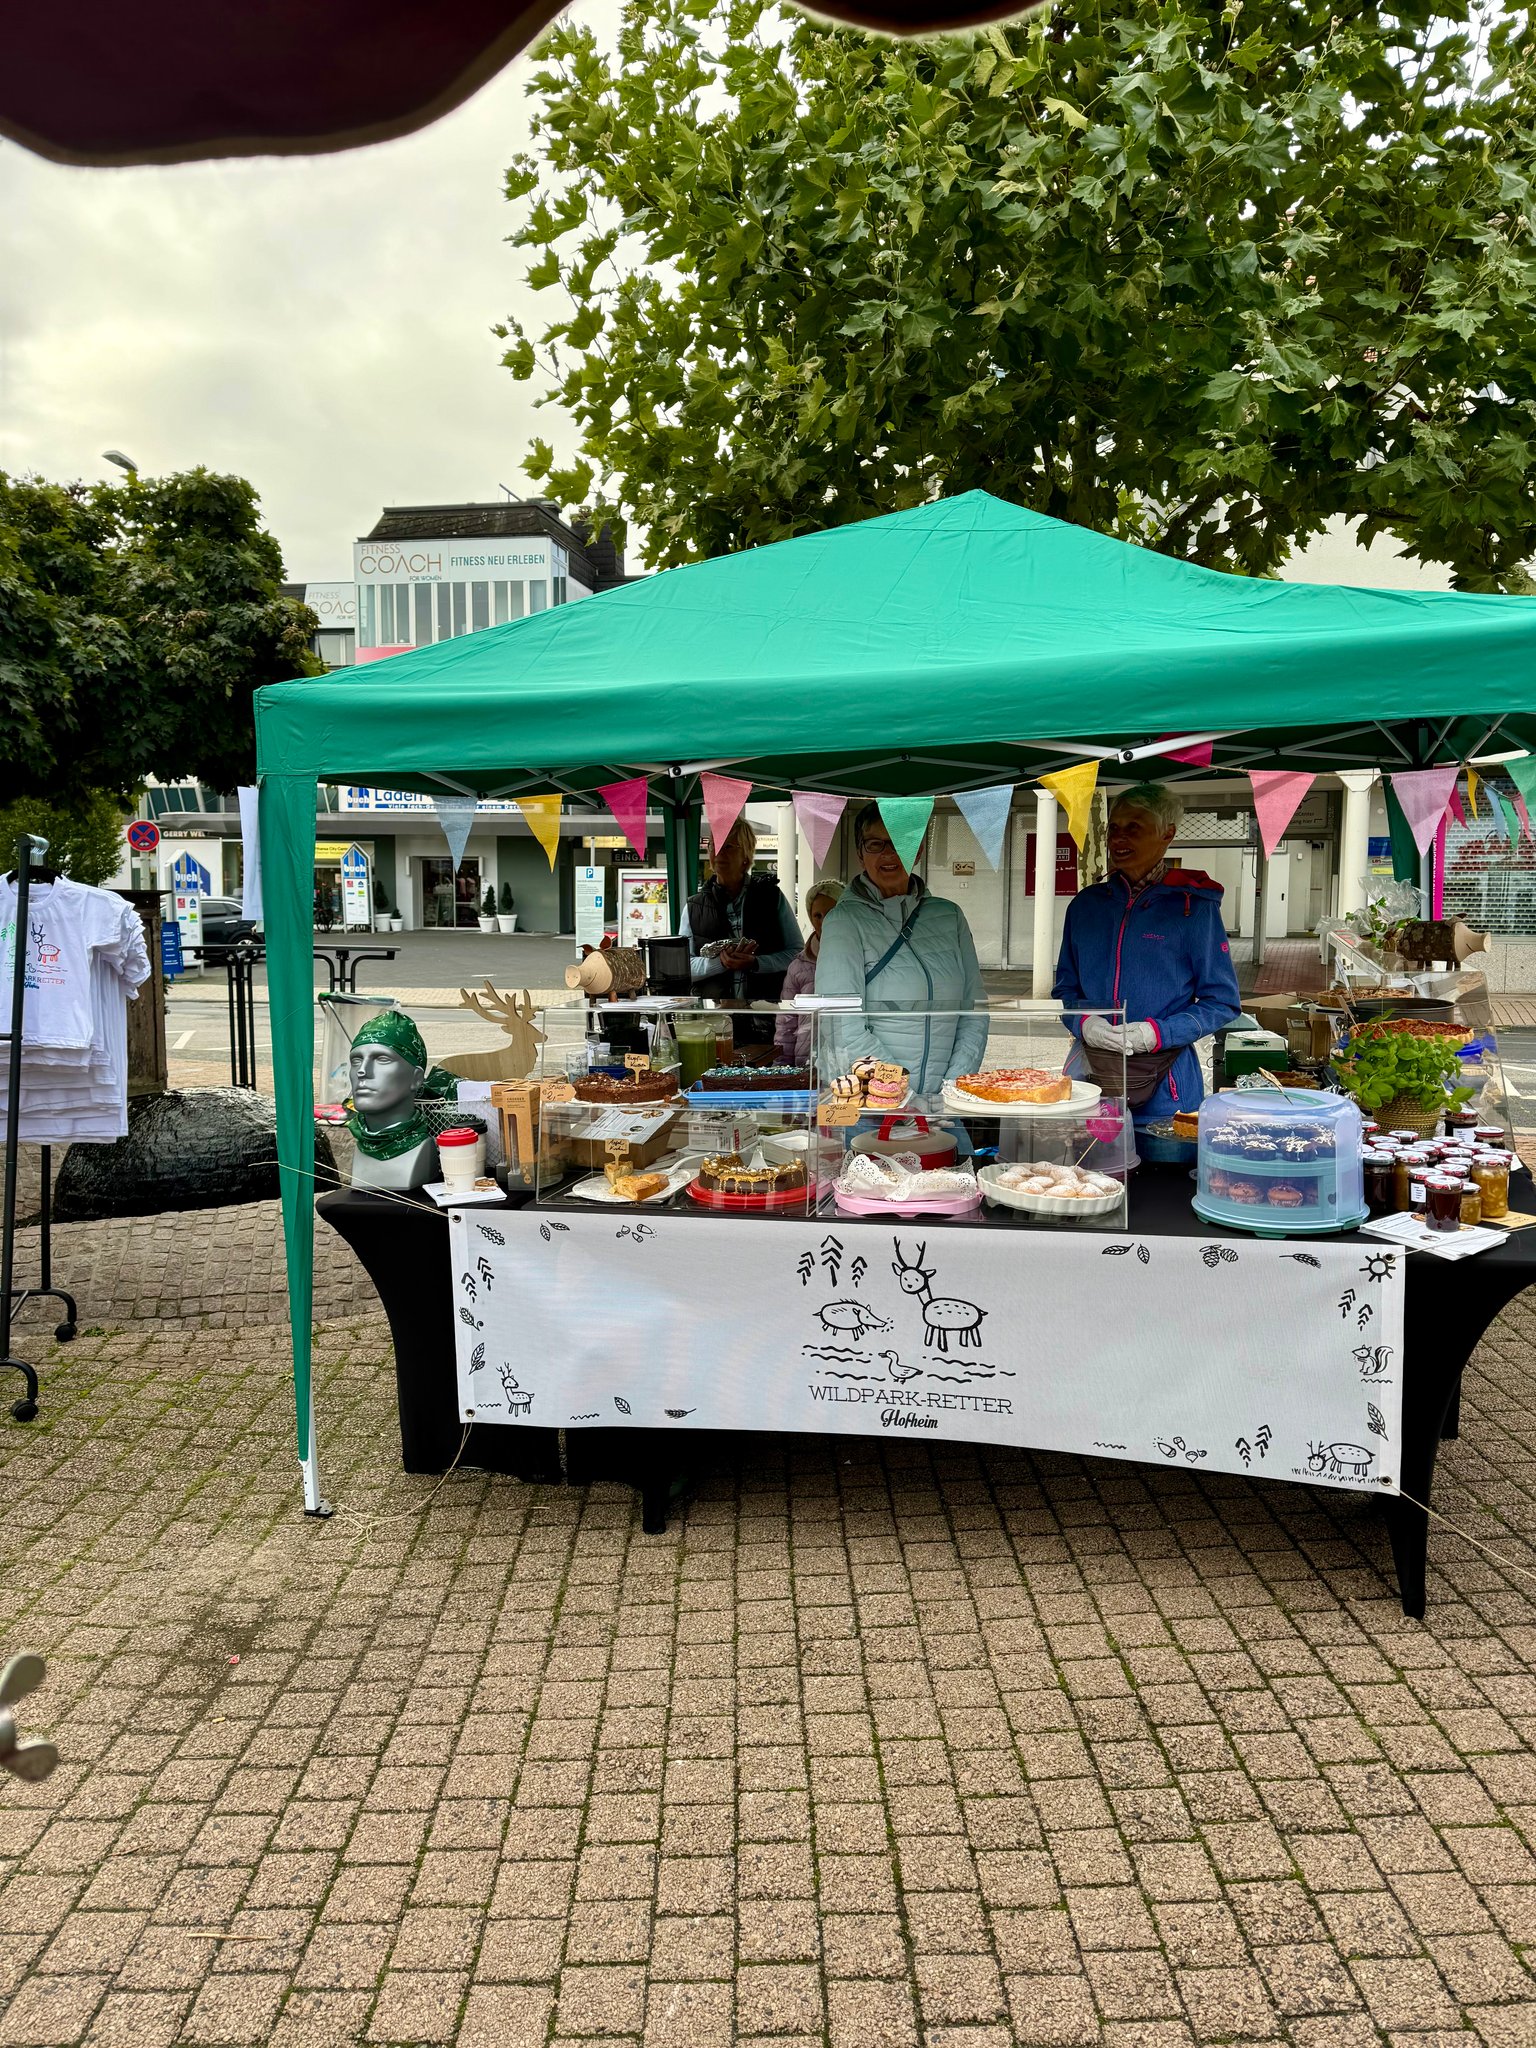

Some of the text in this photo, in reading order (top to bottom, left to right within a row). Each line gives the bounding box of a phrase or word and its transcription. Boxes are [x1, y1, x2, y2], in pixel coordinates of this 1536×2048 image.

[361, 544, 400, 555] FITNESS
[360, 553, 441, 574] COACH
[451, 554, 545, 566] FITNESS NEU ERLEBEN
[308, 591, 339, 599] FITNESS
[347, 795, 369, 803] buch
[163, 830, 188, 838] GERRY
[614, 853, 649, 862] EING
[343, 863, 367, 873] buch
[175, 870, 198, 882] buch
[808, 1384, 1014, 1415] WILDPARK-RETTER
[880, 1408, 939, 1429] Hofheim
